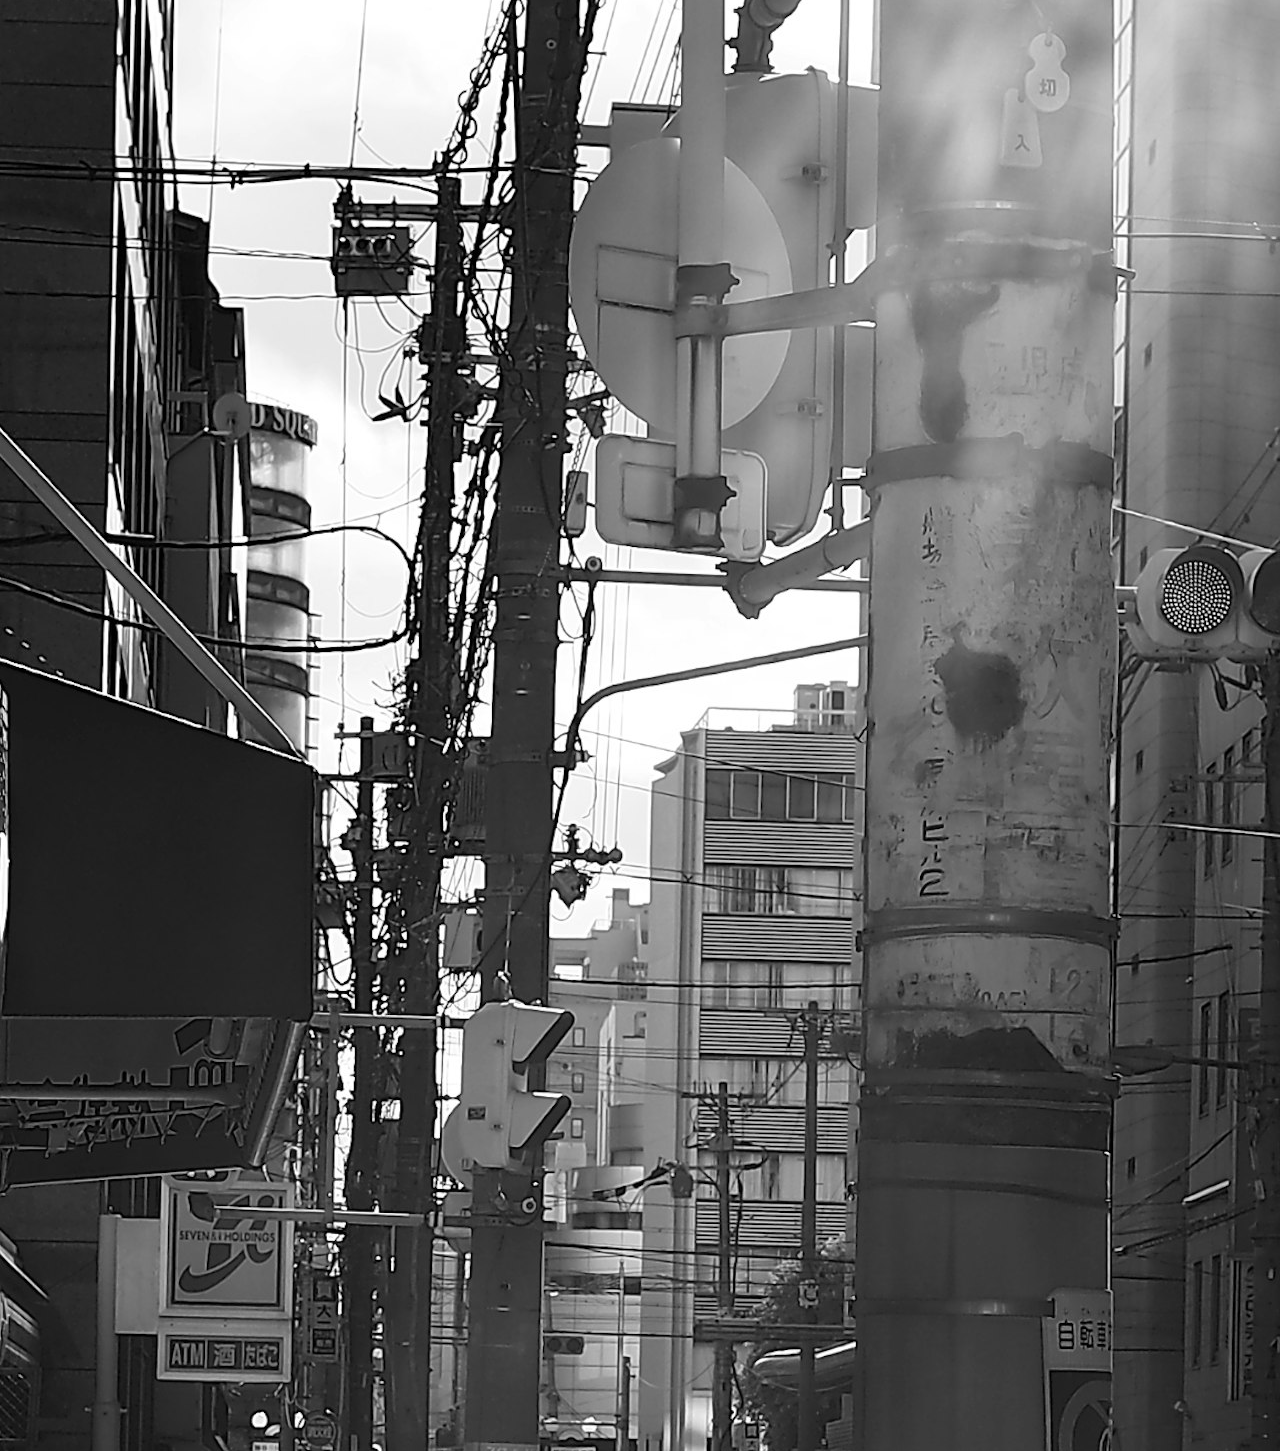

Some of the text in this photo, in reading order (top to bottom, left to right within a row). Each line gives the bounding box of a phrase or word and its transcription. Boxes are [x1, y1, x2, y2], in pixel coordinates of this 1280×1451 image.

[1040, 79, 1057, 97] 切
[225, 1230, 276, 1243] HOLDINGS
[172, 1342, 205, 1367] ATM
[213, 1343, 236, 1368] 酒
